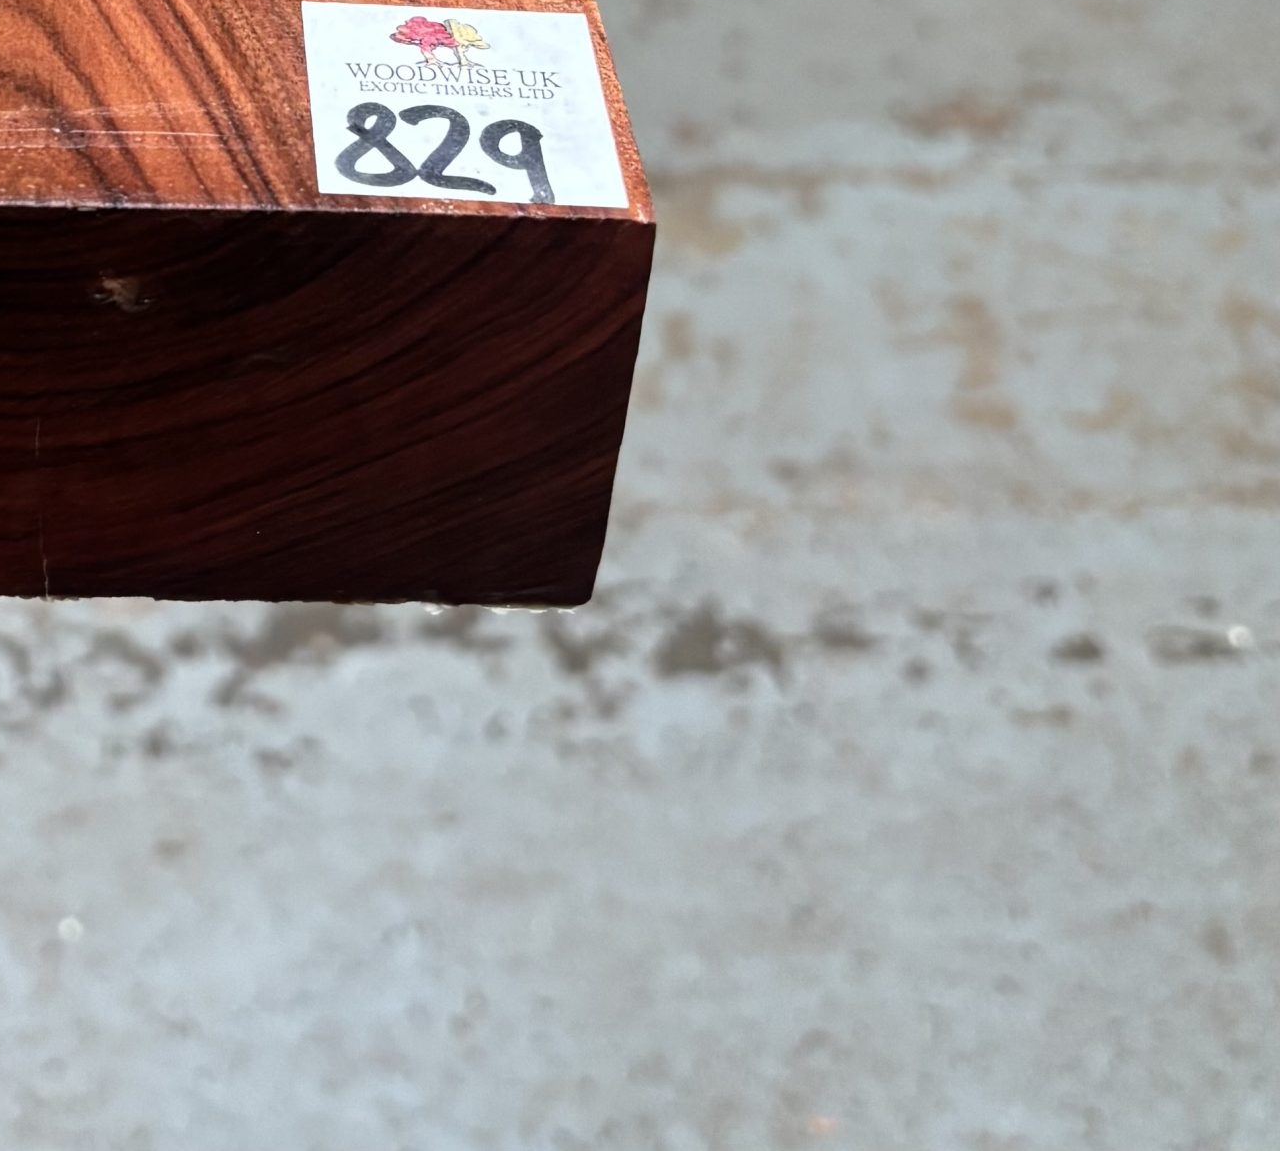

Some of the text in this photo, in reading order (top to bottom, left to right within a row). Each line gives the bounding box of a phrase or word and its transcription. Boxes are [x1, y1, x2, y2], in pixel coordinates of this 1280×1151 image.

[345, 62, 561, 88] WOODWISE UK
[360, 80, 555, 100] EXOTIC TIMBERS LTD
[334, 101, 556, 205] 829
